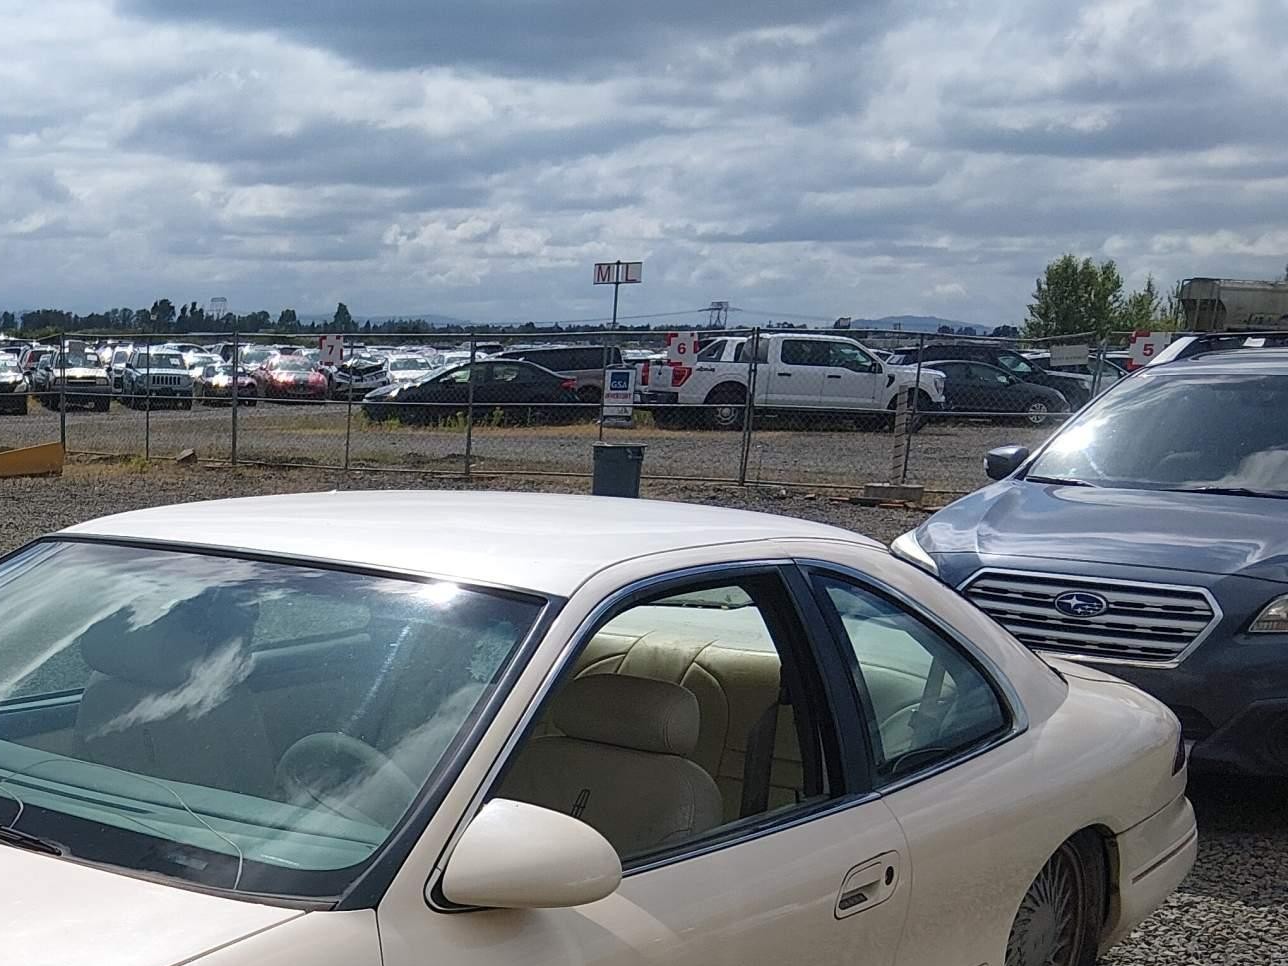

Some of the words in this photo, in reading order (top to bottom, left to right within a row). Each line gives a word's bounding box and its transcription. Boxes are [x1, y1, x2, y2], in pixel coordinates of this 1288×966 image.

[327, 345, 334, 355] 7
[678, 343, 686, 354] 6
[1143, 344, 1154, 356] 5
[611, 380, 628, 389] GSA
